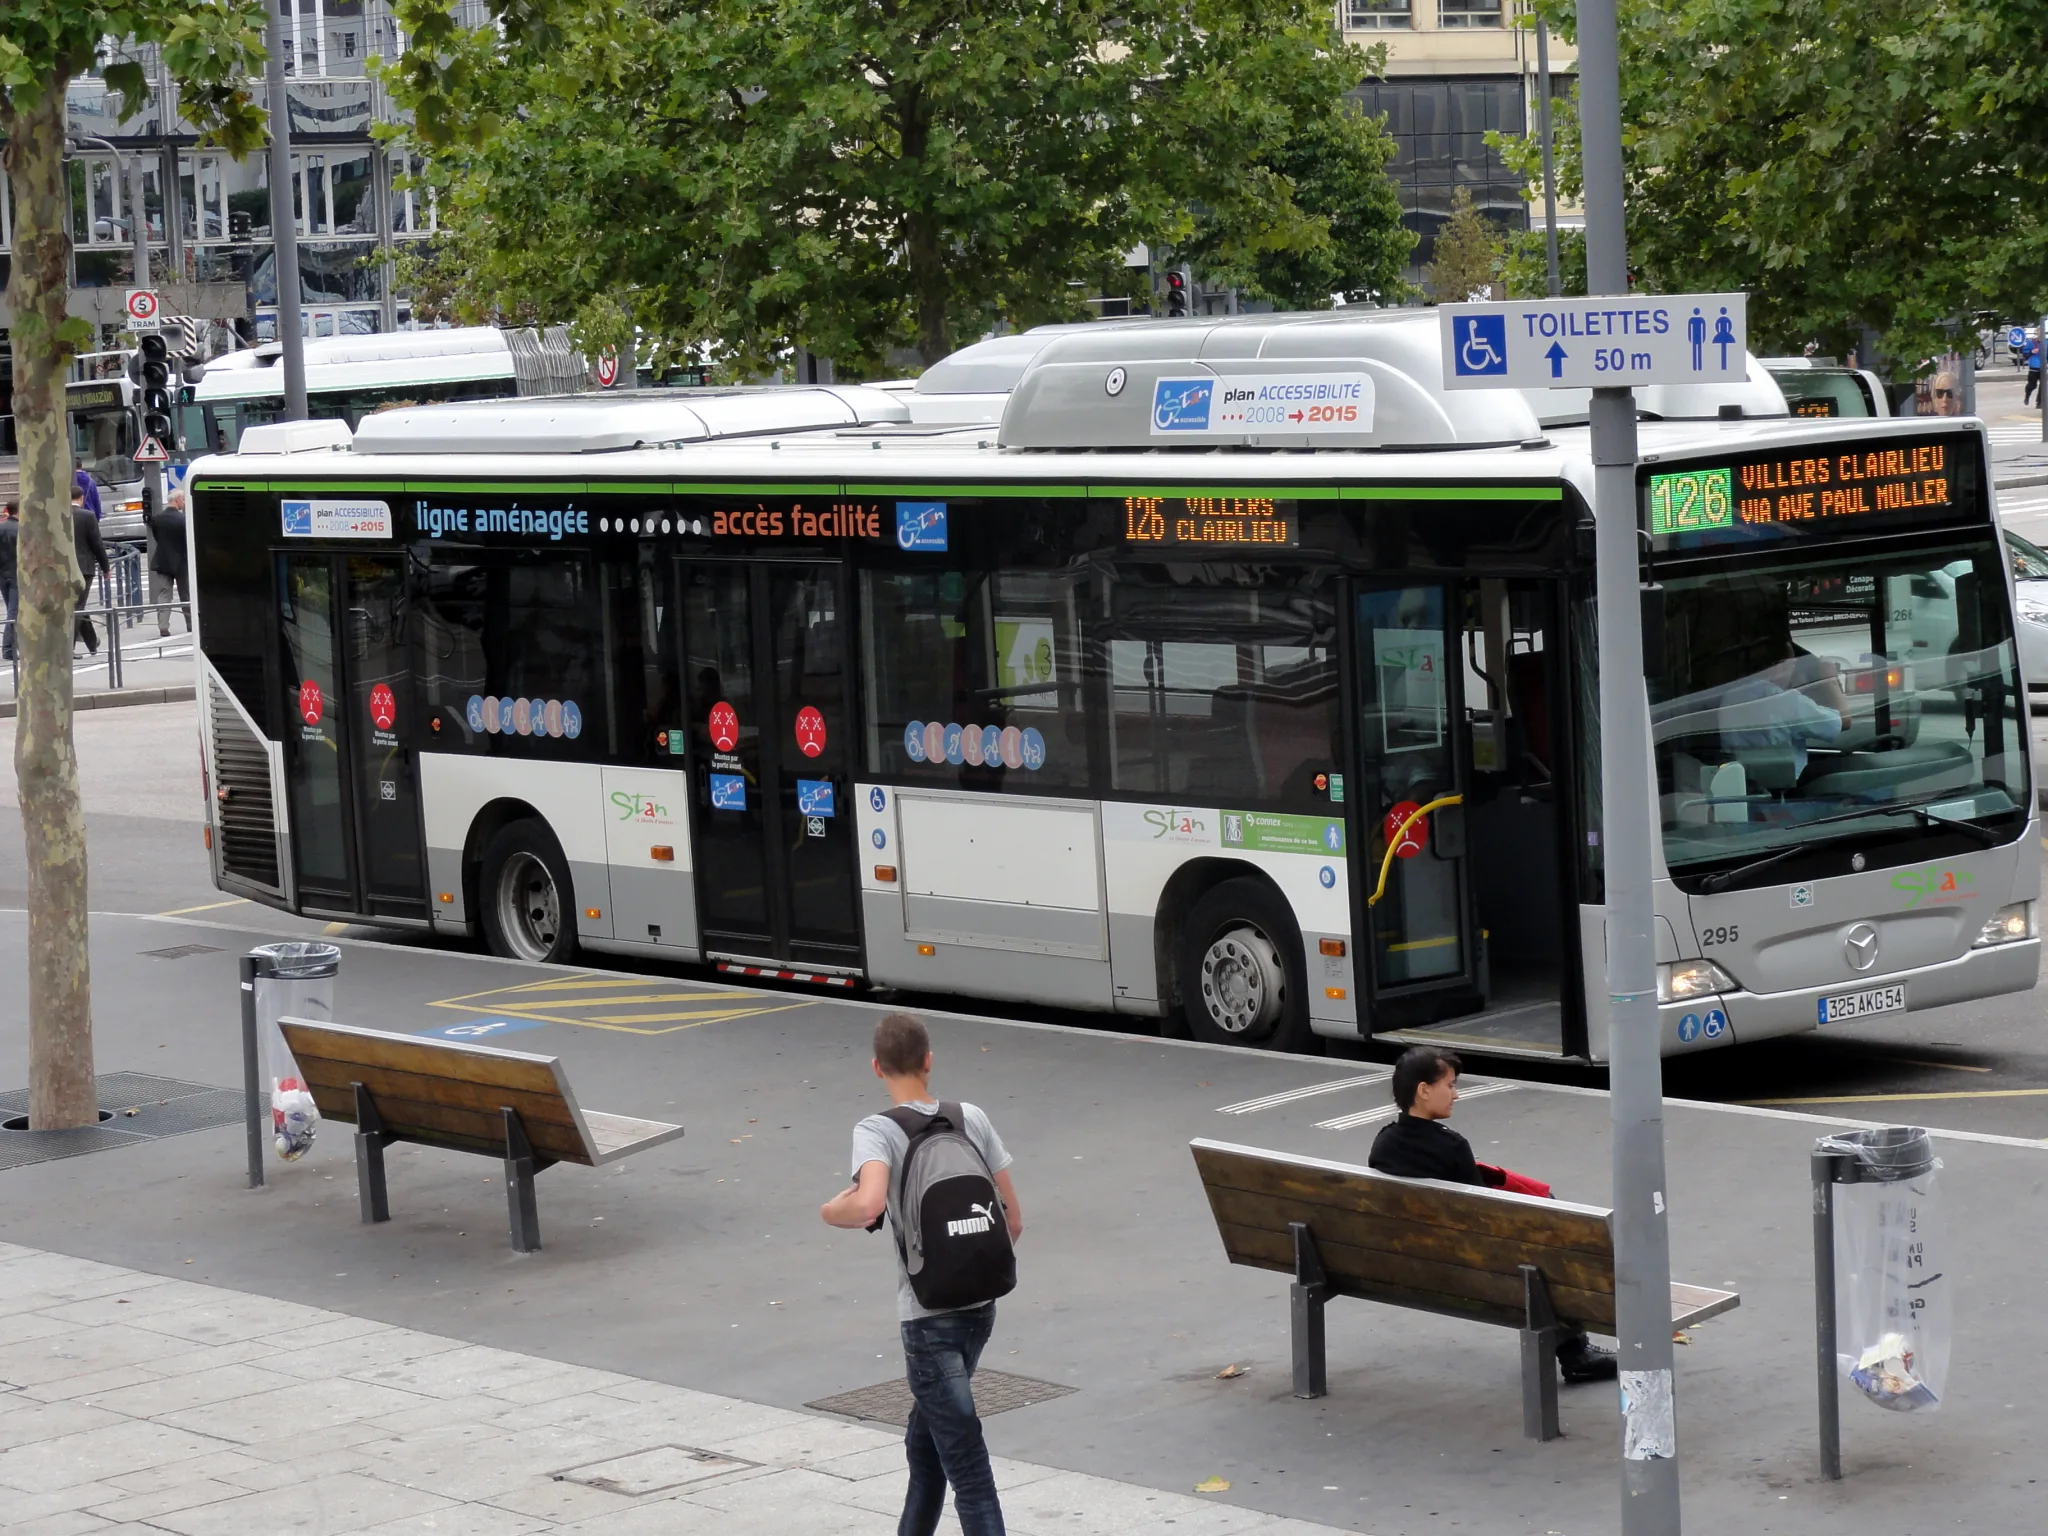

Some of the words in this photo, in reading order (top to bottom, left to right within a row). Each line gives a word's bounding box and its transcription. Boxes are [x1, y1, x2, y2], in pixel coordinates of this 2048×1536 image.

[138, 299, 147, 310] 5
[132, 320, 156, 328] TRAM
[1523, 309, 1669, 337] TOILETTES
[1594, 348, 1625, 371] 50
[1631, 352, 1652, 370] m
[1223, 388, 1255, 404] plan
[1258, 380, 1361, 401] ACCESSIBILITÉ
[1246, 407, 1285, 423] 2008
[1308, 405, 1358, 422] 2015
[1742, 457, 1830, 491] VILLERS
[1839, 445, 1944, 481] CLAIRLIEU
[317, 509, 333, 518] plan
[334, 507, 384, 518] ACCESSIBILITÉ
[1654, 474, 1727, 529] 126
[1740, 499, 1772, 524] VIA
[1778, 492, 1815, 522] AVE
[1822, 486, 1871, 516] PAUL
[1876, 478, 1948, 510] MULLER
[360, 521, 384, 532] 2015
[416, 500, 468, 538] ligne
[475, 503, 589, 541] aménagée
[713, 503, 784, 536] accès
[791, 504, 880, 538] facilité
[1125, 496, 1165, 540] 126
[1186, 498, 1274, 516] VILLERS
[1176, 520, 1287, 542] CLAIRLIEU
[610, 791, 668, 821] Stan
[1143, 809, 1205, 839] Stan
[1256, 818, 1281, 826] connex
[1891, 865, 1974, 908] Stan
[1703, 926, 1739, 946] 295
[1829, 995, 1855, 1018] 325
[1858, 993, 1885, 1013] AKG
[1885, 988, 1903, 1007] 54
[947, 1216, 990, 1237] PUMA
